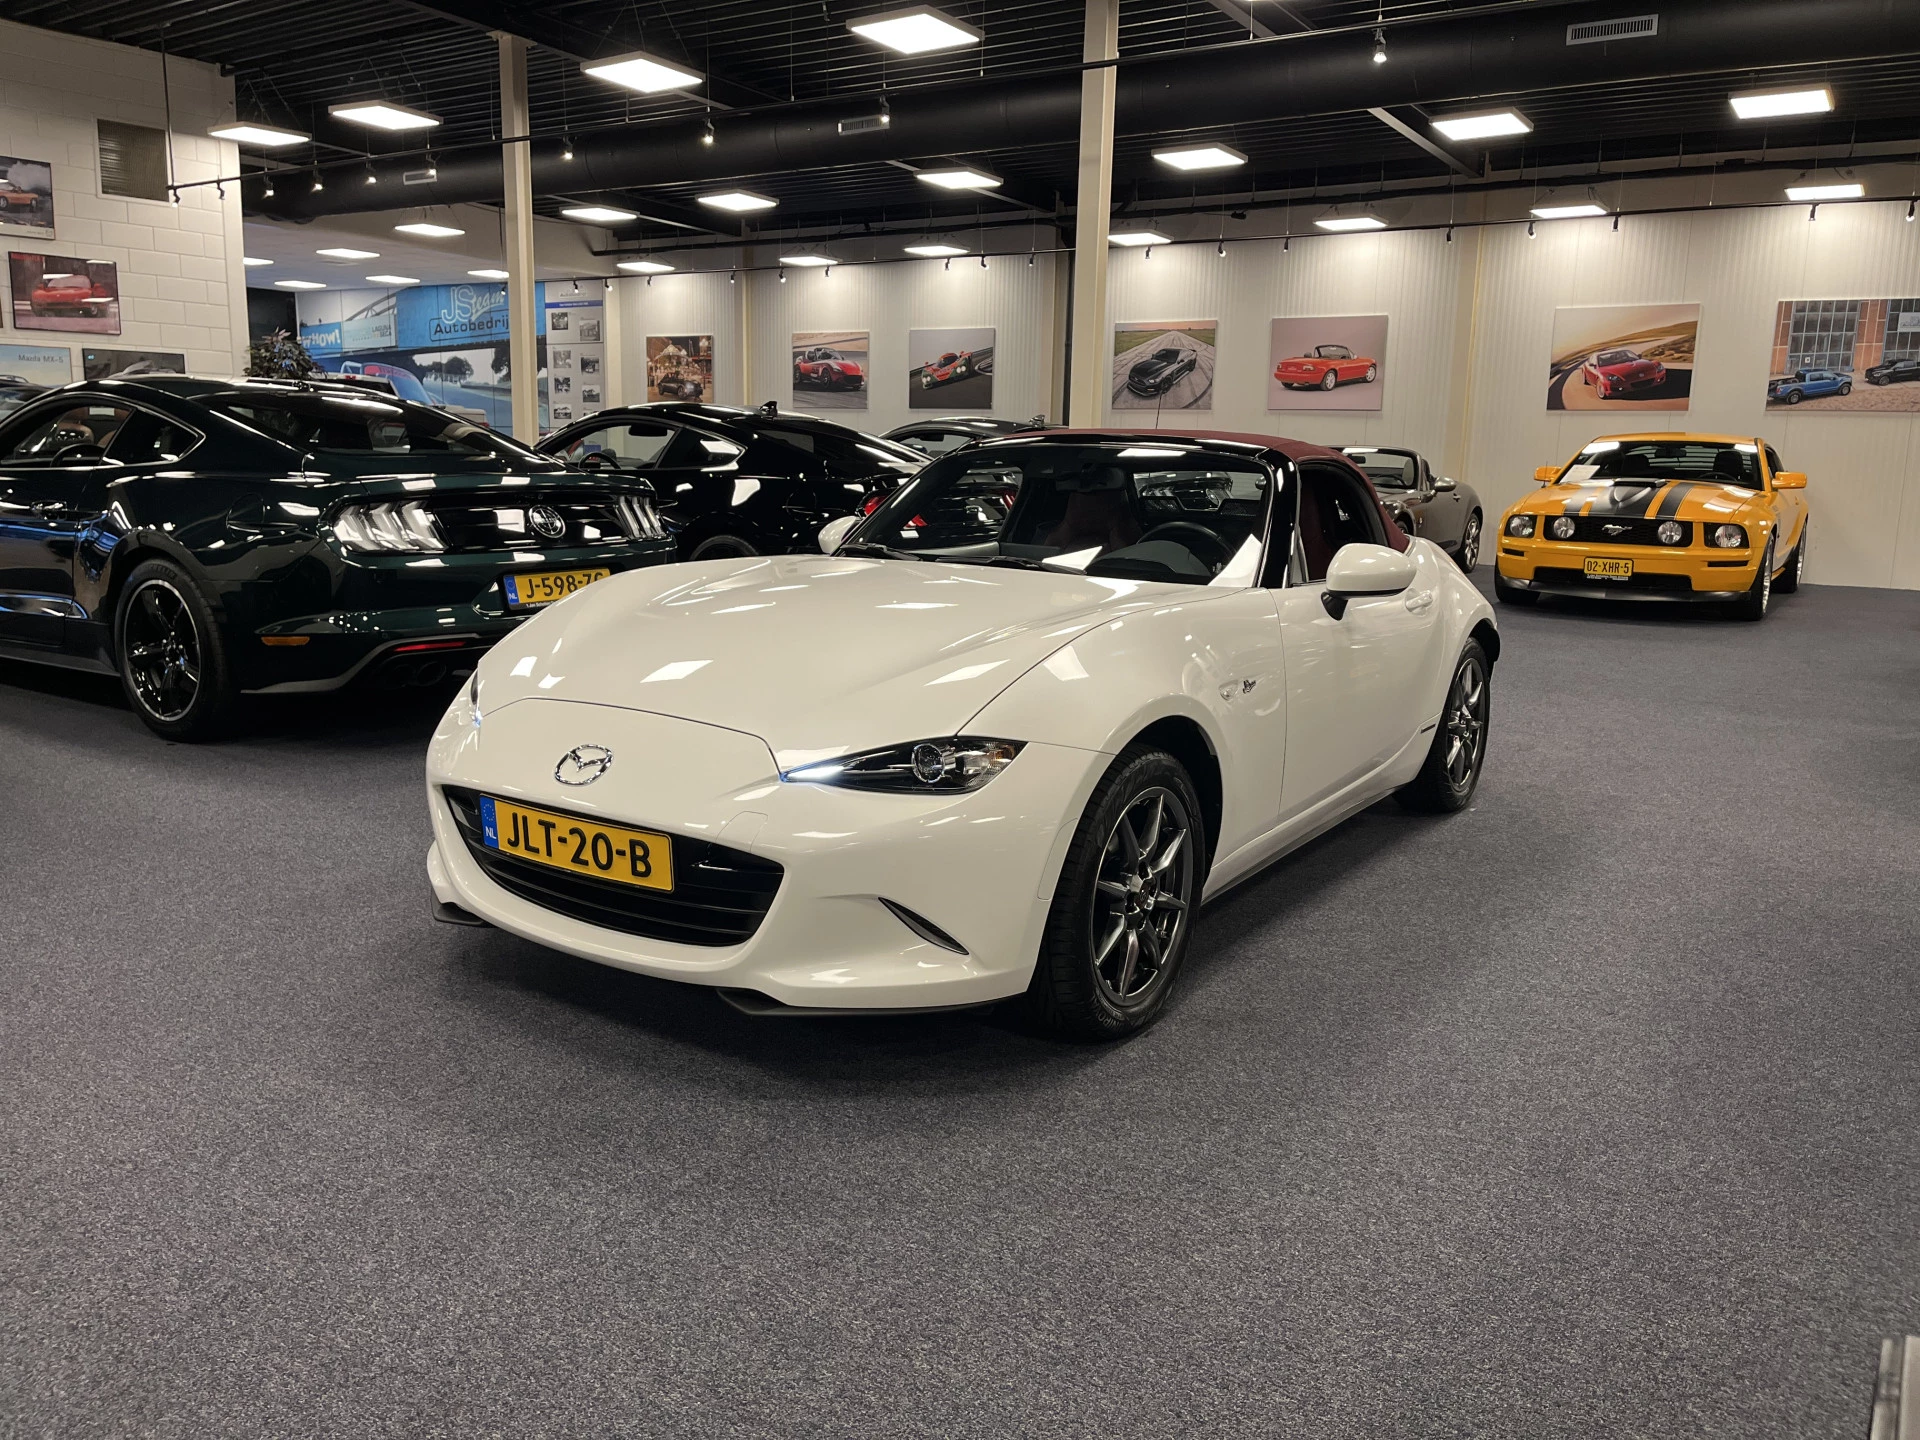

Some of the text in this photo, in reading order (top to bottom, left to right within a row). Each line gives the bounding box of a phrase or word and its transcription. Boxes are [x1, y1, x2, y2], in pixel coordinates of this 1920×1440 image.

[18, 354, 64, 363] Mazda MX-5
[1586, 560, 1630, 574] 02-XHR-5
[508, 592, 518, 600] NL
[485, 826, 497, 840] NL
[507, 811, 652, 878] JLT-20-B
